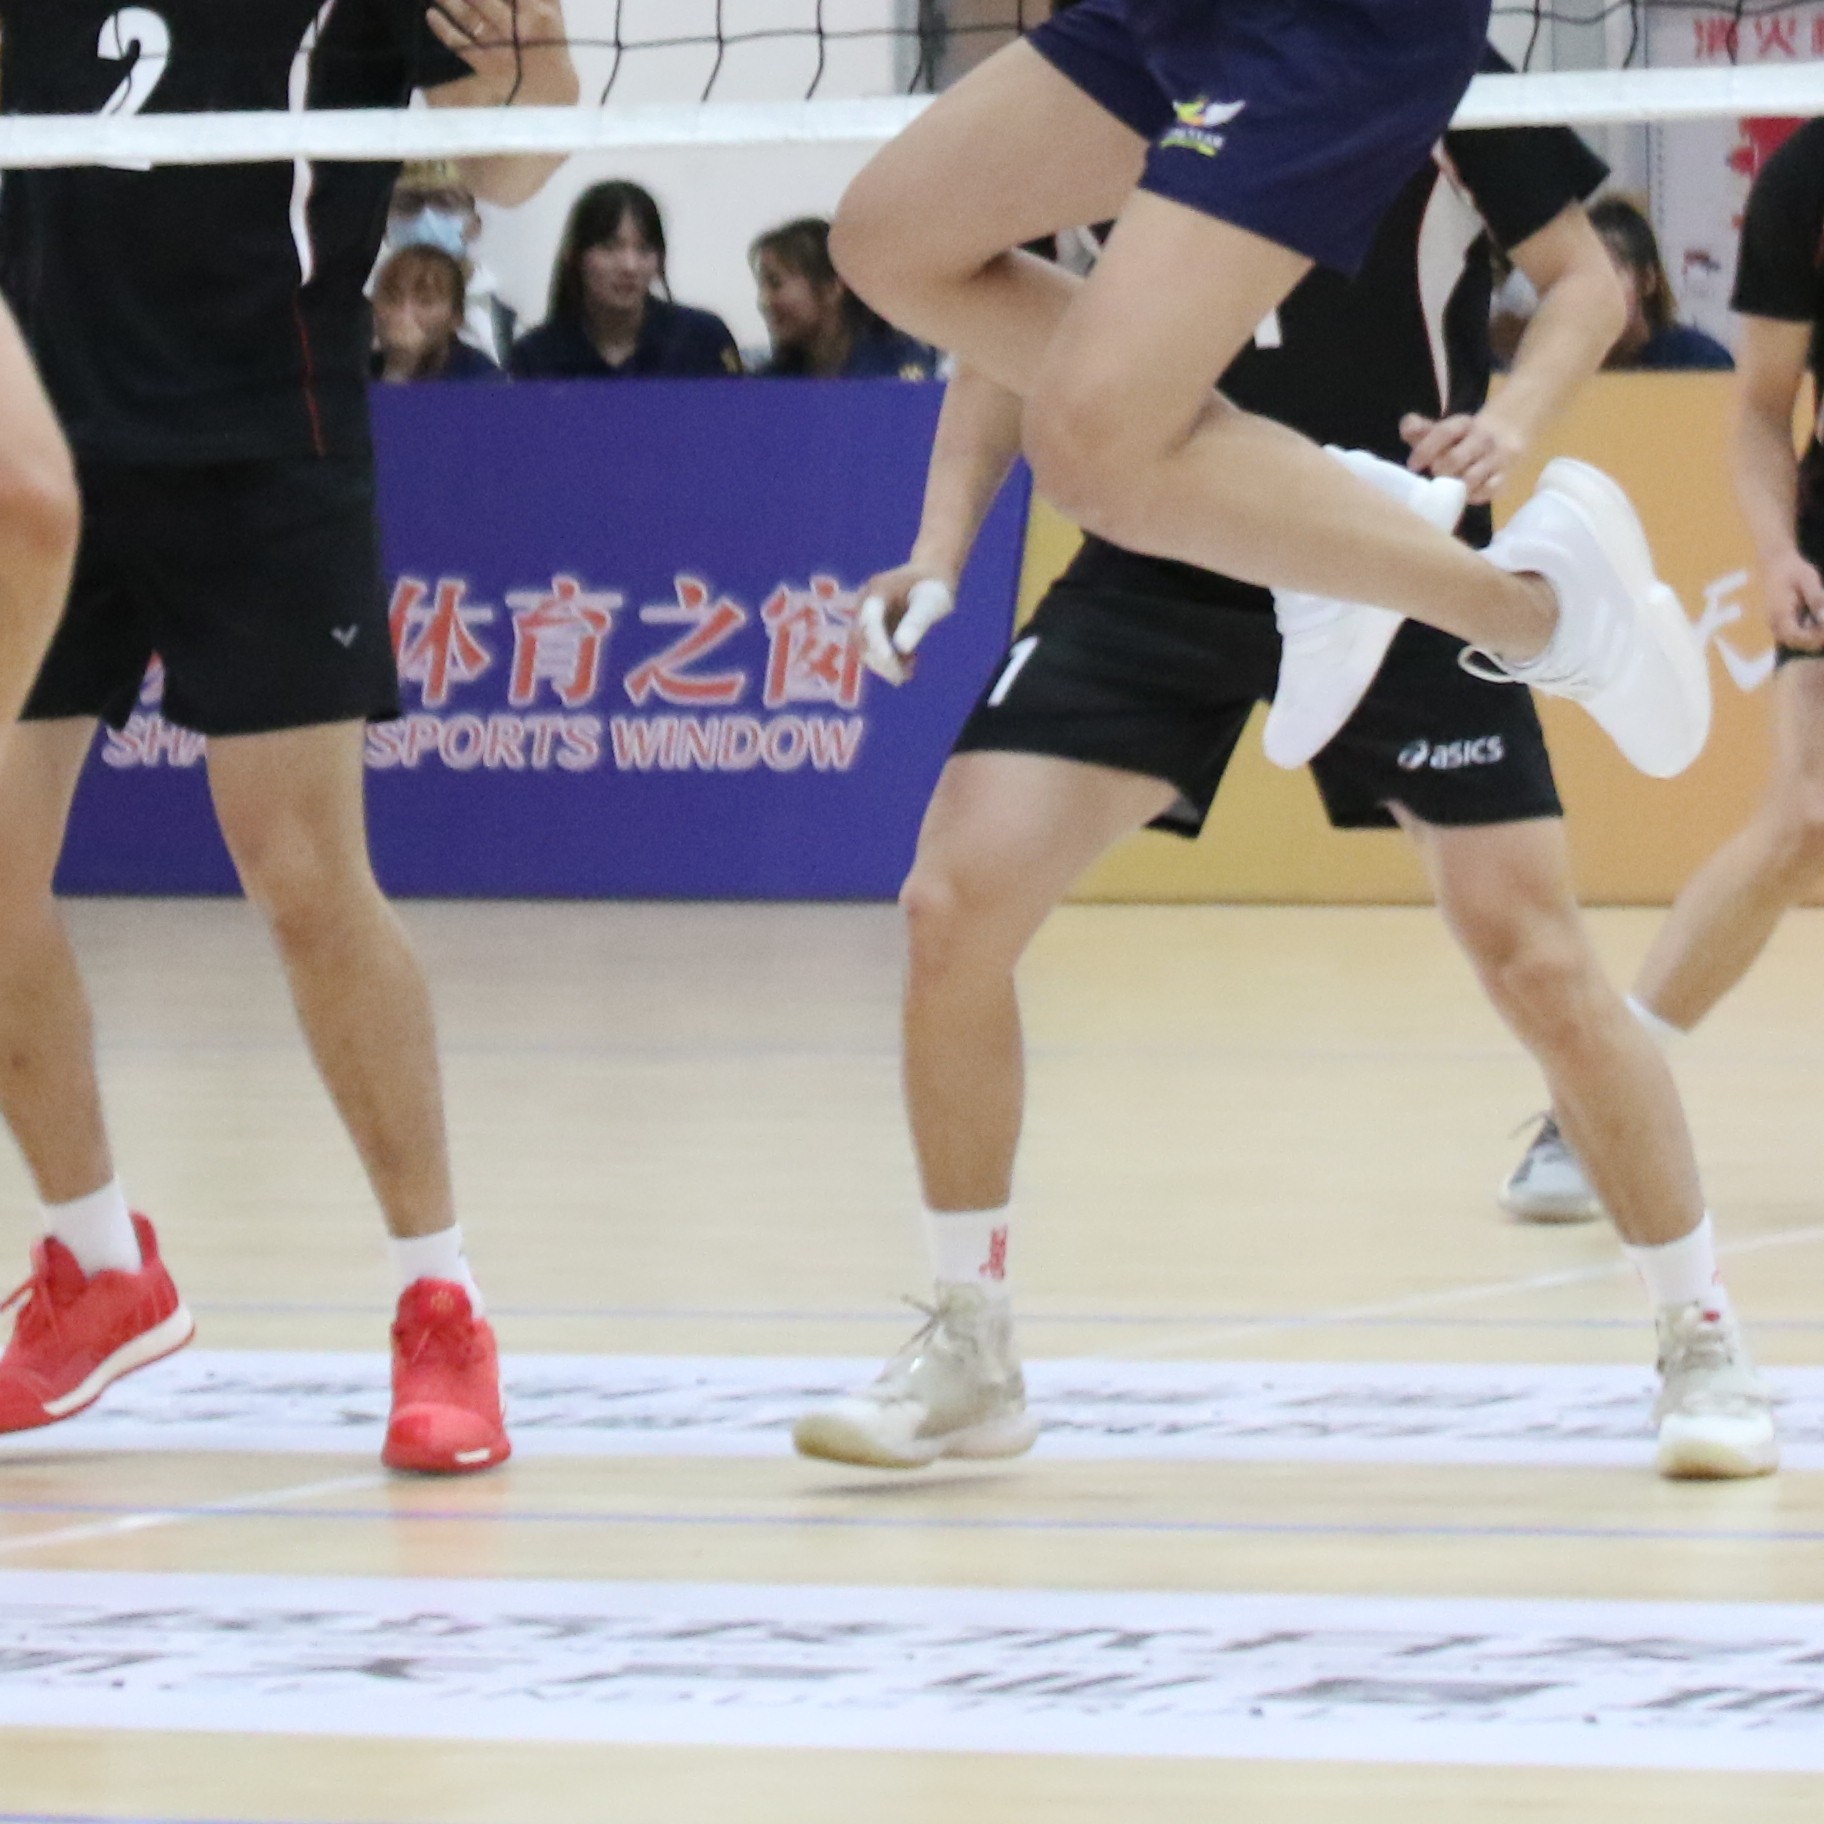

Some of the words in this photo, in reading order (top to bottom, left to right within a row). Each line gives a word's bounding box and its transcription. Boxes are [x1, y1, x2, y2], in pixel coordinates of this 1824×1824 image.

[388, 574, 864, 708] 体育之窗
[987, 634, 1039, 709] 1
[365, 713, 601, 770] SPORTS
[609, 713, 863, 771] WINDOW
[1429, 735, 1505, 770] asics
